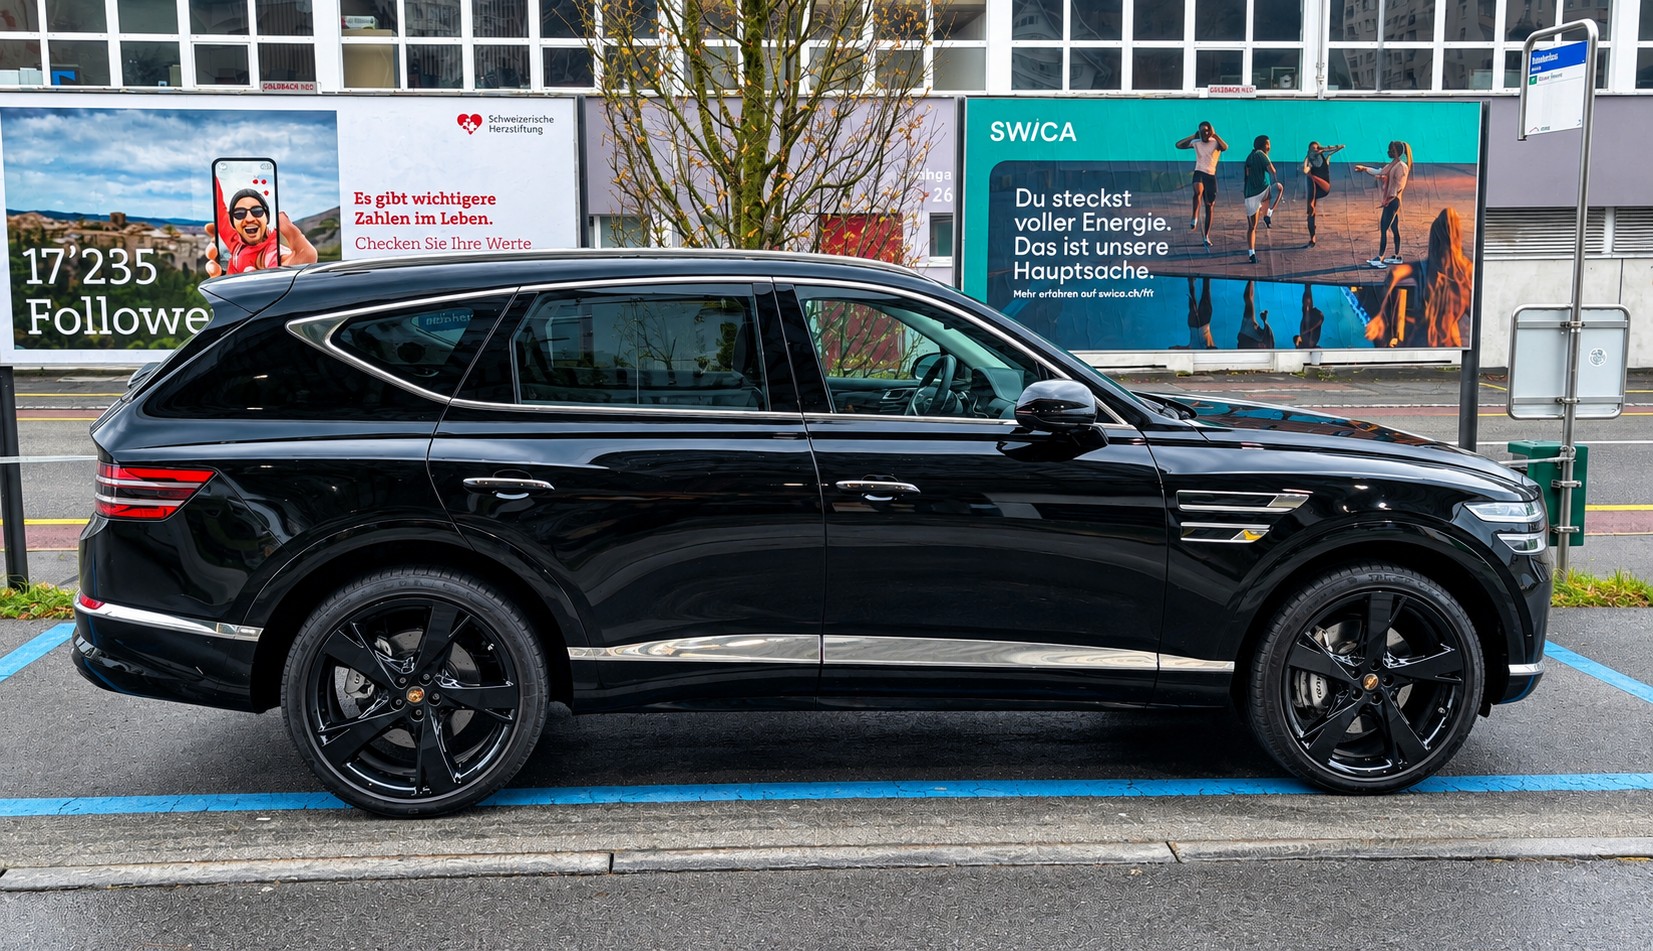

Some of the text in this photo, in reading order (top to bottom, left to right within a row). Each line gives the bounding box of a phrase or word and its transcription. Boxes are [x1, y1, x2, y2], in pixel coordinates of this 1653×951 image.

[488, 114, 555, 124] Schweizerische
[488, 124, 544, 136] Herzstiftung
[354, 191, 497, 209] Es gibt wichtigere
[932, 186, 953, 203] 26
[1015, 187, 1132, 208] Du steckst
[354, 211, 493, 226] Zahlen im Leben.
[1014, 211, 1172, 237] voller Energie.
[355, 236, 532, 250] Checken Sie Ihre Werte
[1014, 235, 1169, 256] Das ist unsere
[1014, 259, 1155, 285] Hauptsache.
[1013, 289, 1036, 298] Mehr
[1038, 289, 1079, 298] erfahren
[1080, 289, 1097, 298] auf
[25, 295, 210, 336] Followe
